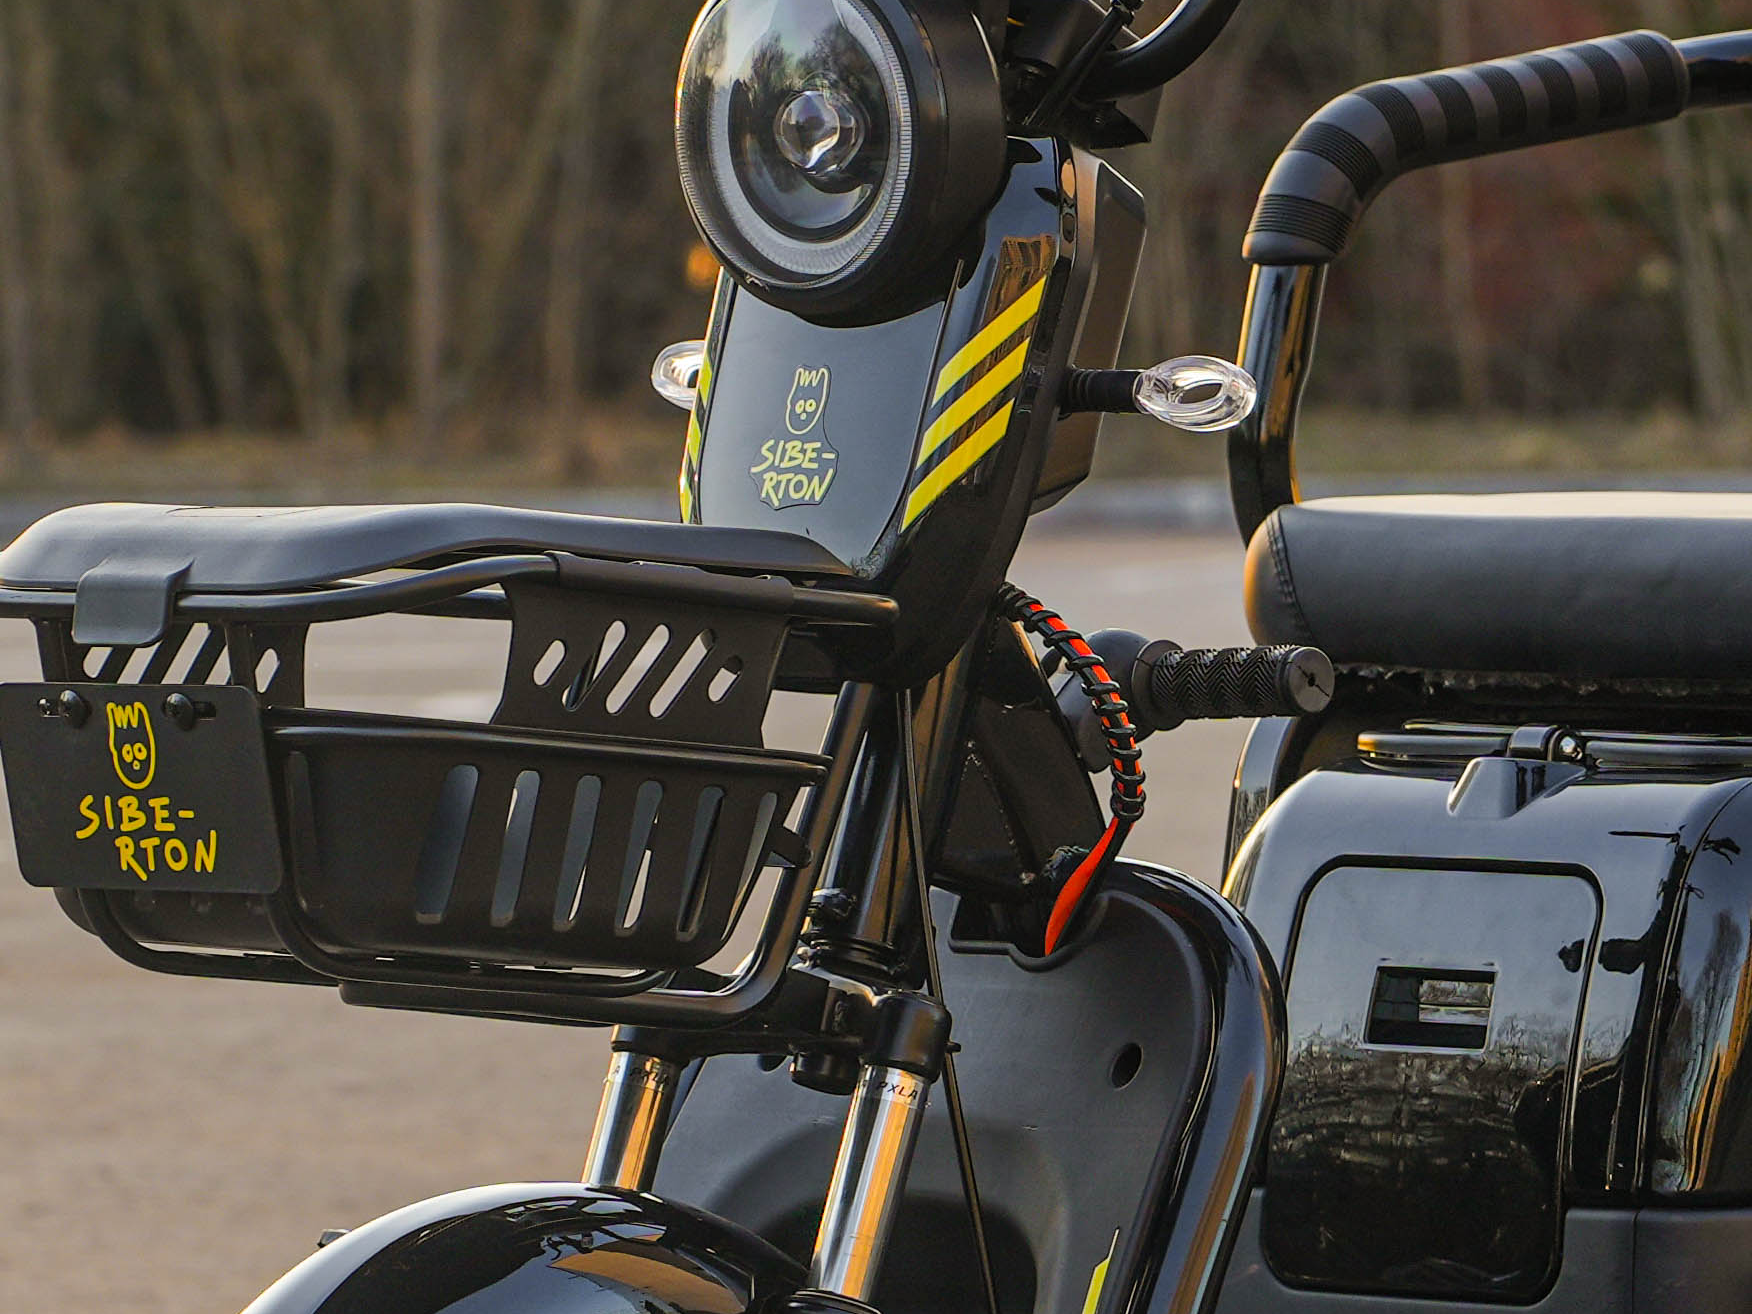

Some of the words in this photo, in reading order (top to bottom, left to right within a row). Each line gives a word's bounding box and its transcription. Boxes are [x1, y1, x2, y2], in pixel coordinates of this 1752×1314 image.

[750, 439, 835, 473] SIBE-
[761, 469, 834, 507] RTON
[76, 795, 195, 839] SIBE-
[115, 830, 216, 881] RTON
